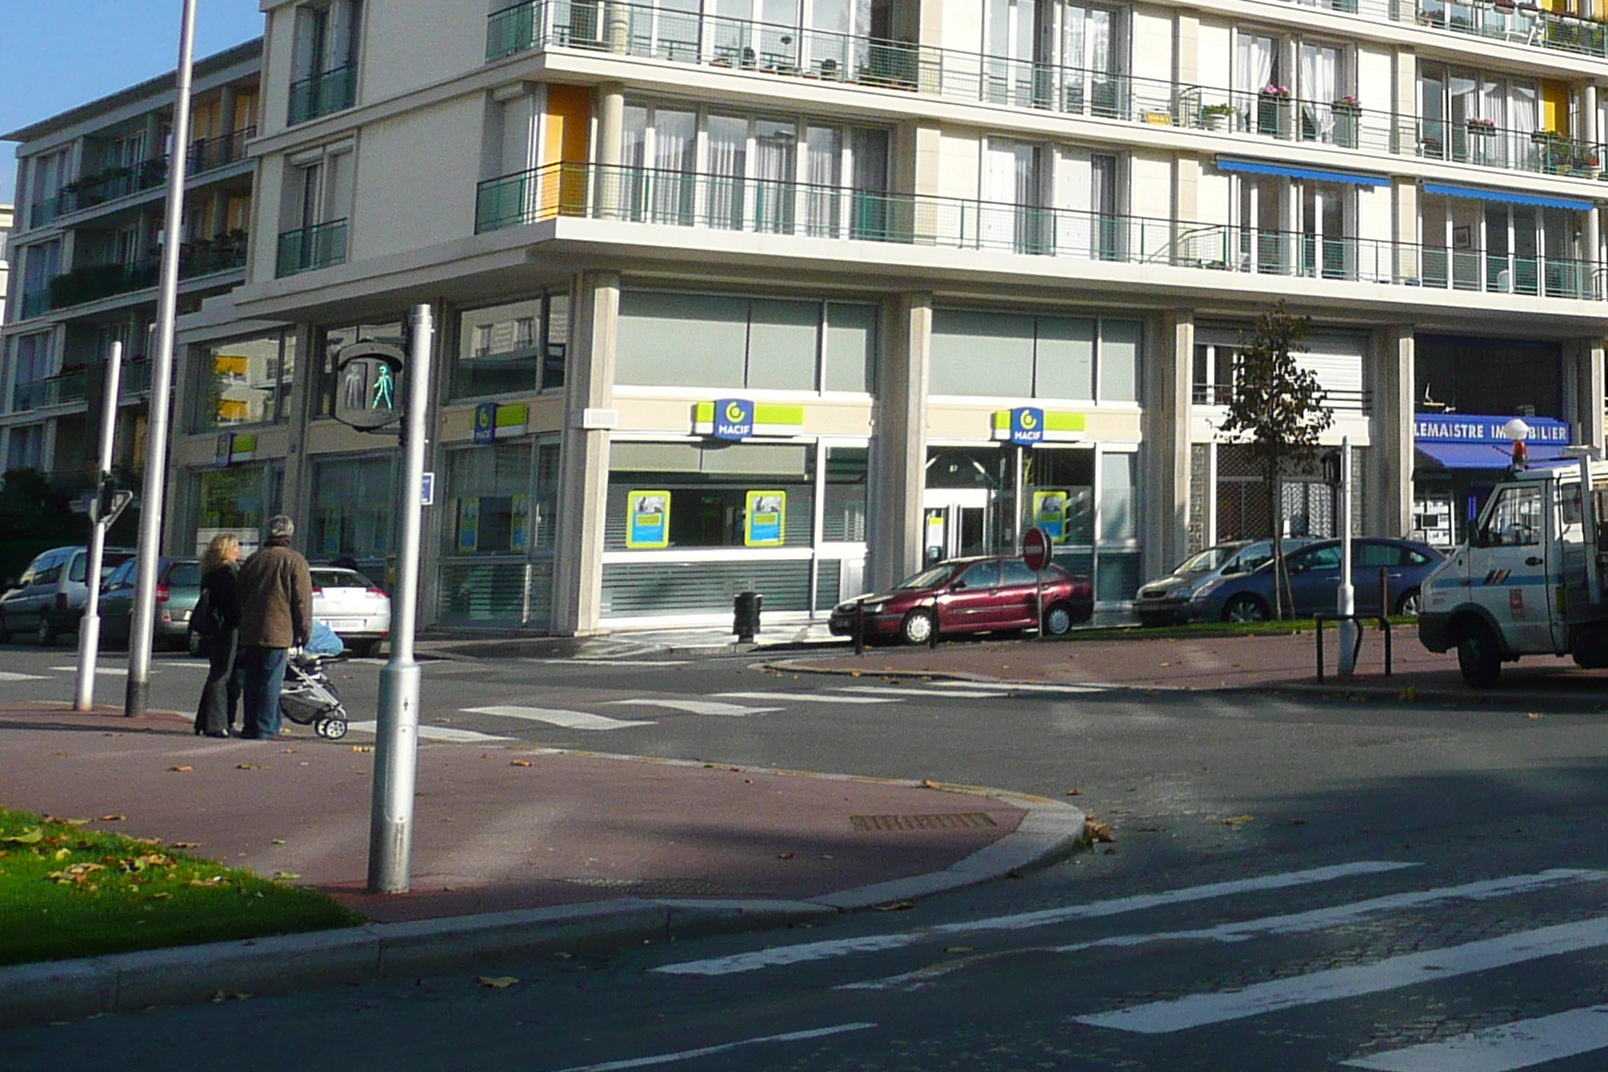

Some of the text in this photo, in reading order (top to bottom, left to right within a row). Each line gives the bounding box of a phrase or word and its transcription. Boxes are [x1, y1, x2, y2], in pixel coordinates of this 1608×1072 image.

[718, 425, 750, 435] MACIF
[1413, 423, 1566, 440] LEMAISTRE IMBILIER
[1014, 431, 1041, 440] MACIF
